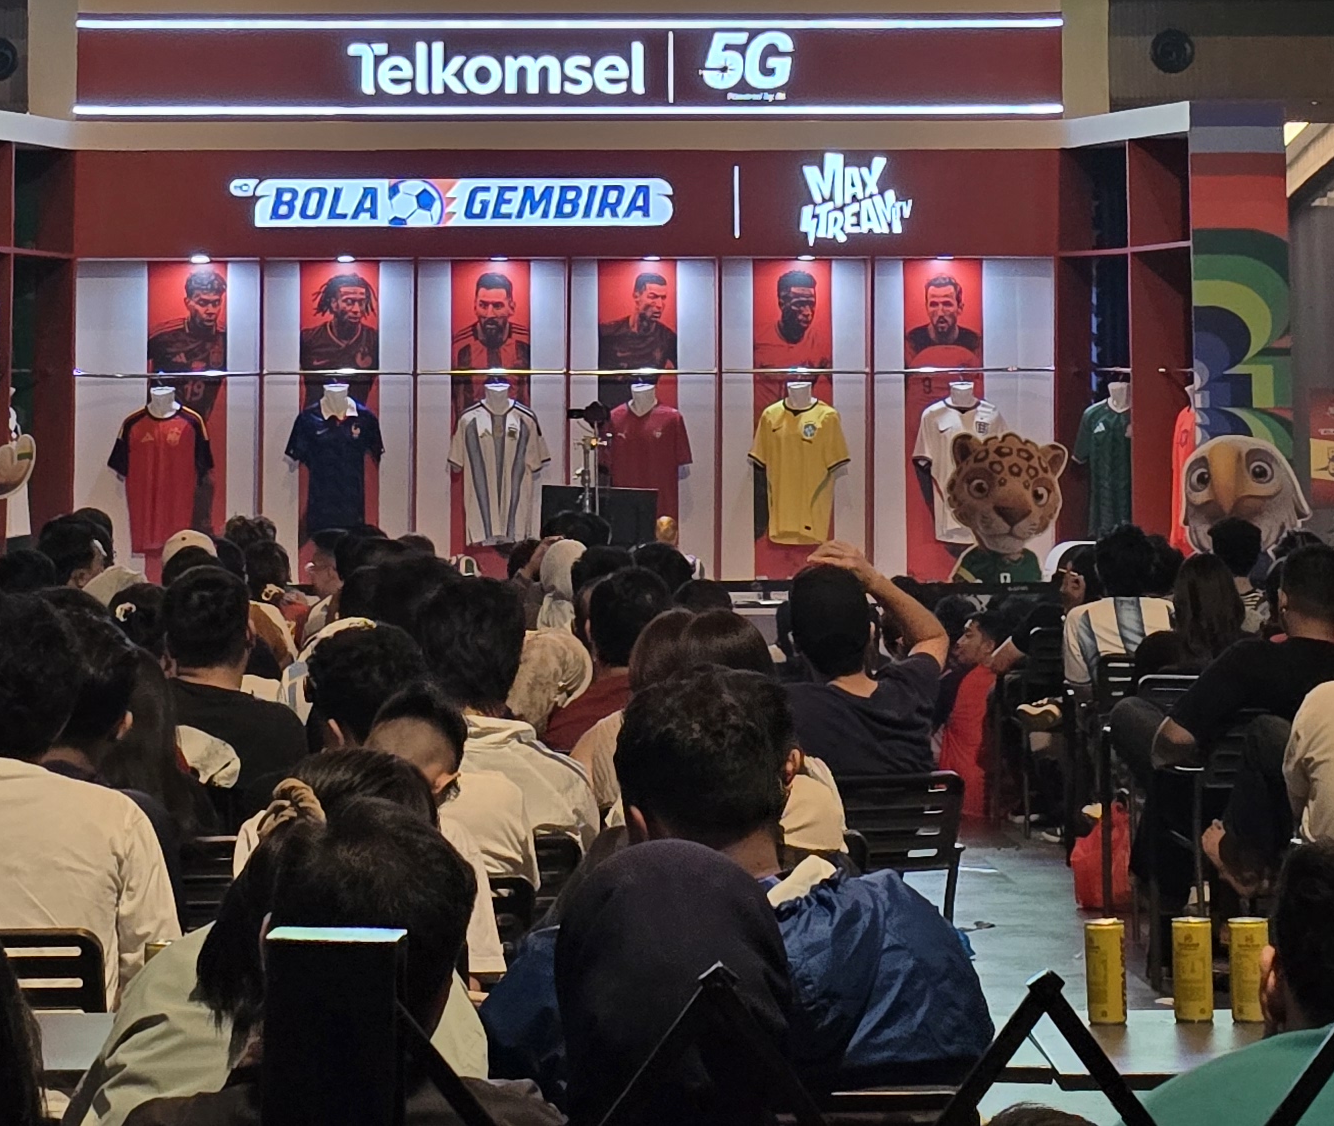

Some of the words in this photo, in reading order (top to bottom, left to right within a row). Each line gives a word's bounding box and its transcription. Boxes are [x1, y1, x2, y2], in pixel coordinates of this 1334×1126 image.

[347, 40, 645, 96] Telkomsel
[701, 30, 795, 91] 5G
[269, 186, 379, 221] BOLA
[463, 184, 651, 220] GEMBIRA
[802, 152, 887, 208] MAX
[799, 189, 903, 248] STREAM
[184, 380, 205, 402] 19
